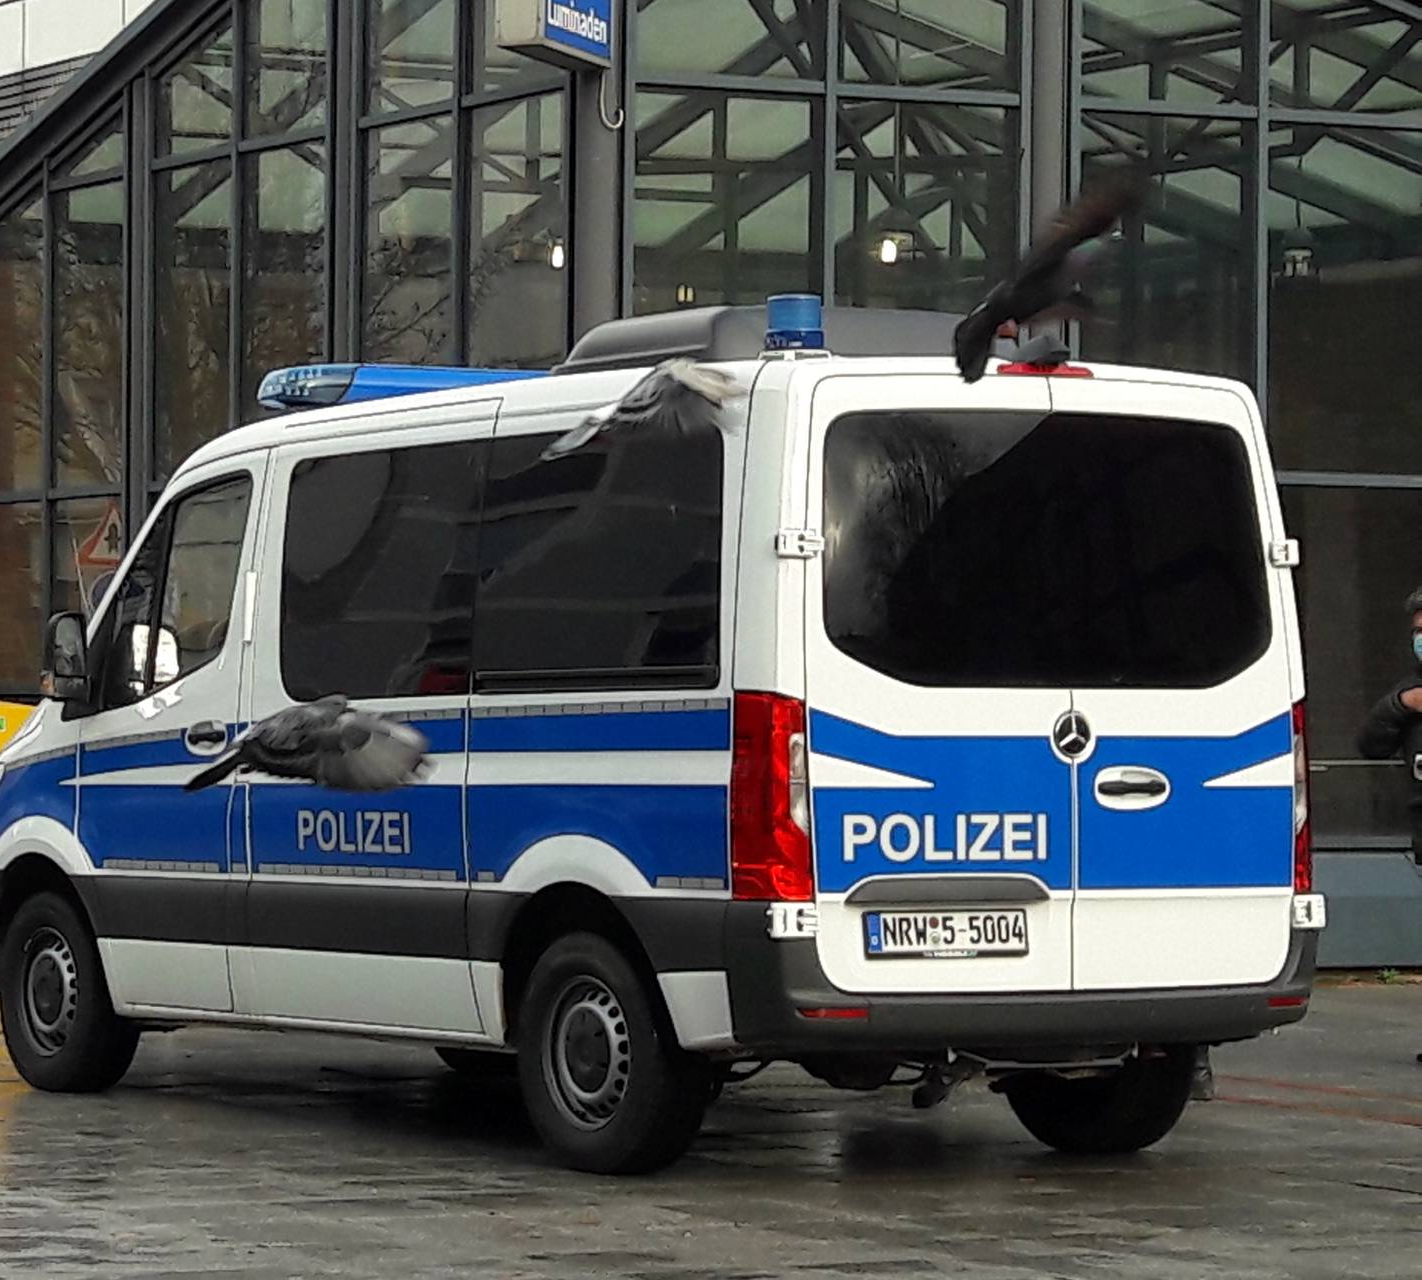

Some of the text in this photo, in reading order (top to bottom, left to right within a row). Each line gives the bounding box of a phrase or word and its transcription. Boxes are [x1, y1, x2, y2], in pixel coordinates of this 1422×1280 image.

[547, 0, 607, 44] Luminaden
[297, 809, 411, 854] POLIZEI
[842, 812, 1048, 862] POLIZEI
[882, 914, 1024, 946] NRW 5-5004
